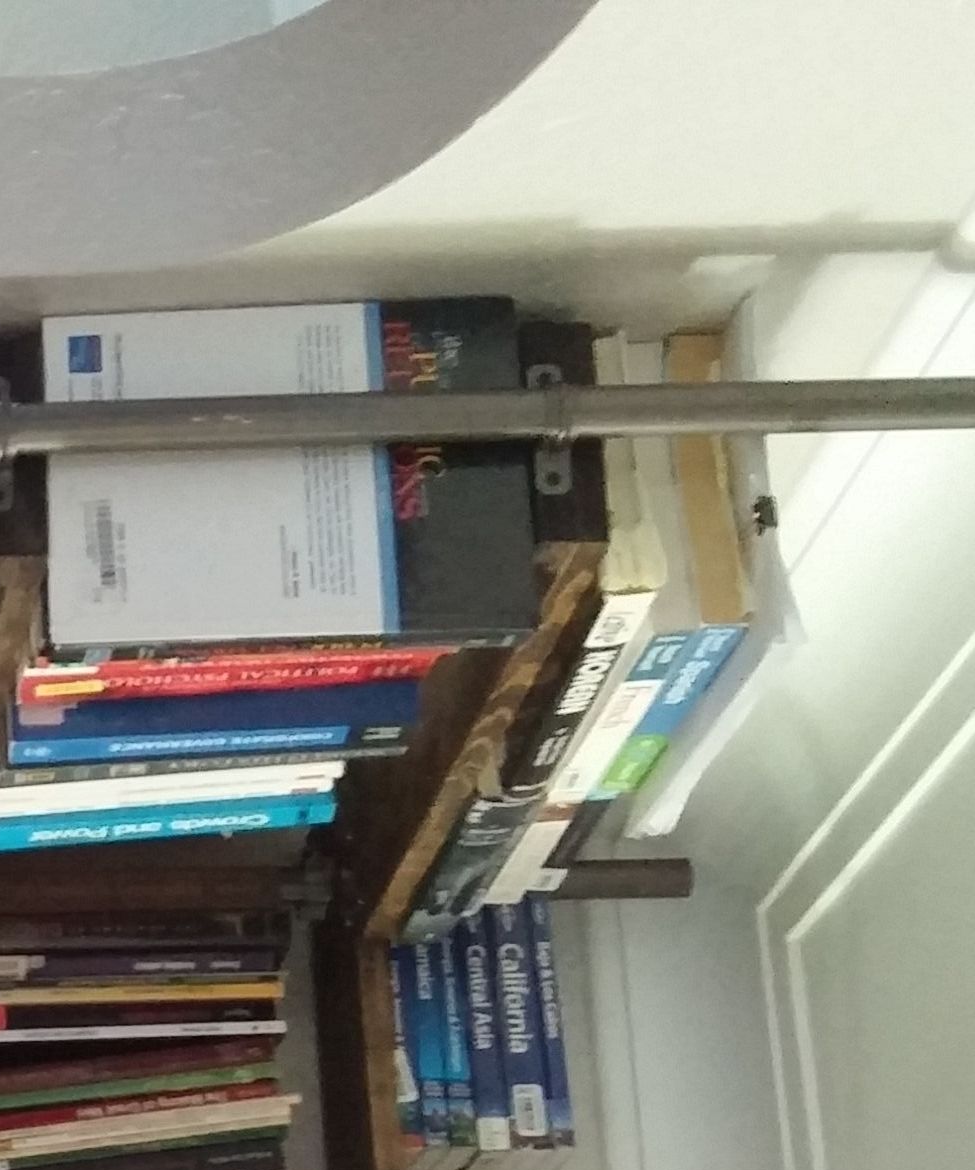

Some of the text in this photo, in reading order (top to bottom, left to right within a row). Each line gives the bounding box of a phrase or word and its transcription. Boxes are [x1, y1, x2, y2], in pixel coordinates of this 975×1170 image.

[554, 649, 621, 716] KOREAN
[27, 814, 270, 843] Crowds and Power
[415, 943, 433, 1000] amaica
[467, 945, 495, 1050] Central Asia
[497, 943, 534, 1054] California
